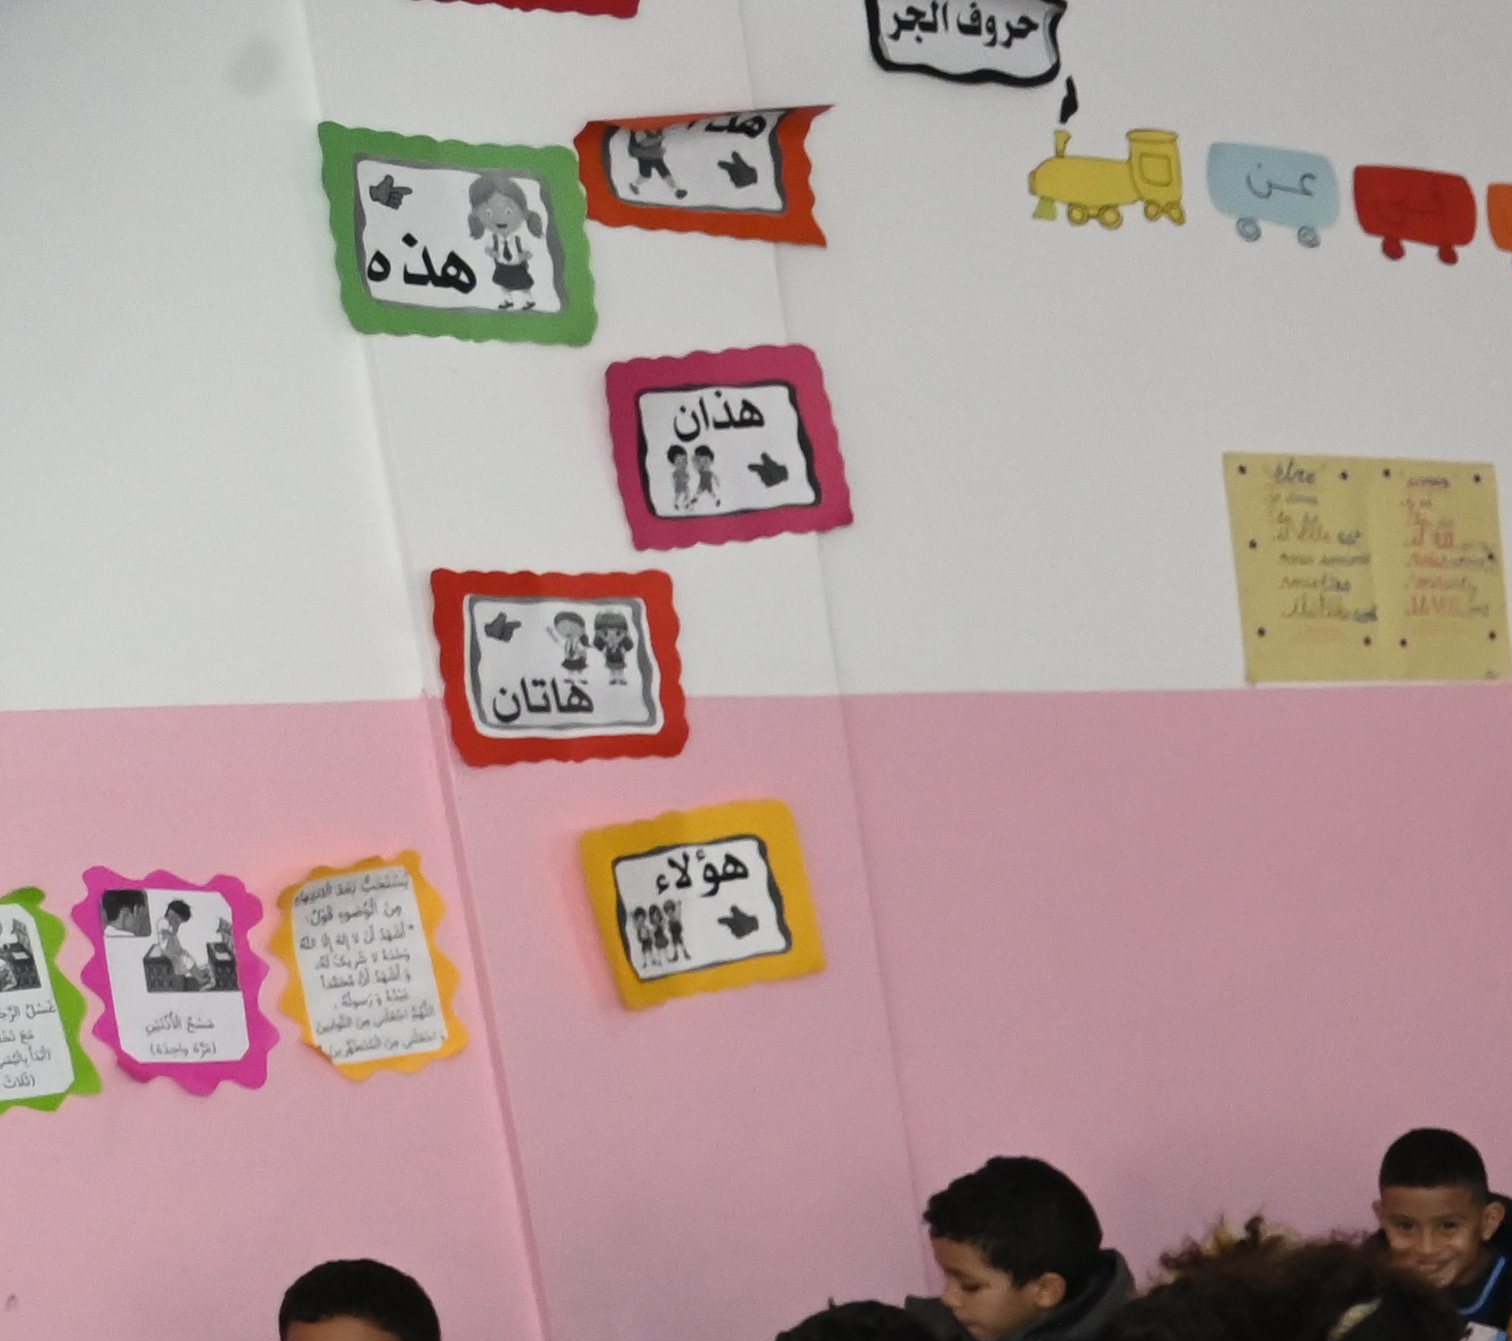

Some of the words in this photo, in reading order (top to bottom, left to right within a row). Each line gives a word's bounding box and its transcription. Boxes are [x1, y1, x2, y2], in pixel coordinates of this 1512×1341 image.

[887, 2, 950, 43] الجر
[956, 6, 1040, 48] حروف
[364, 232, 478, 297] هذه
[671, 390, 767, 442] هذان
[491, 679, 596, 723] هاتان
[653, 848, 750, 900] هؤلاء
